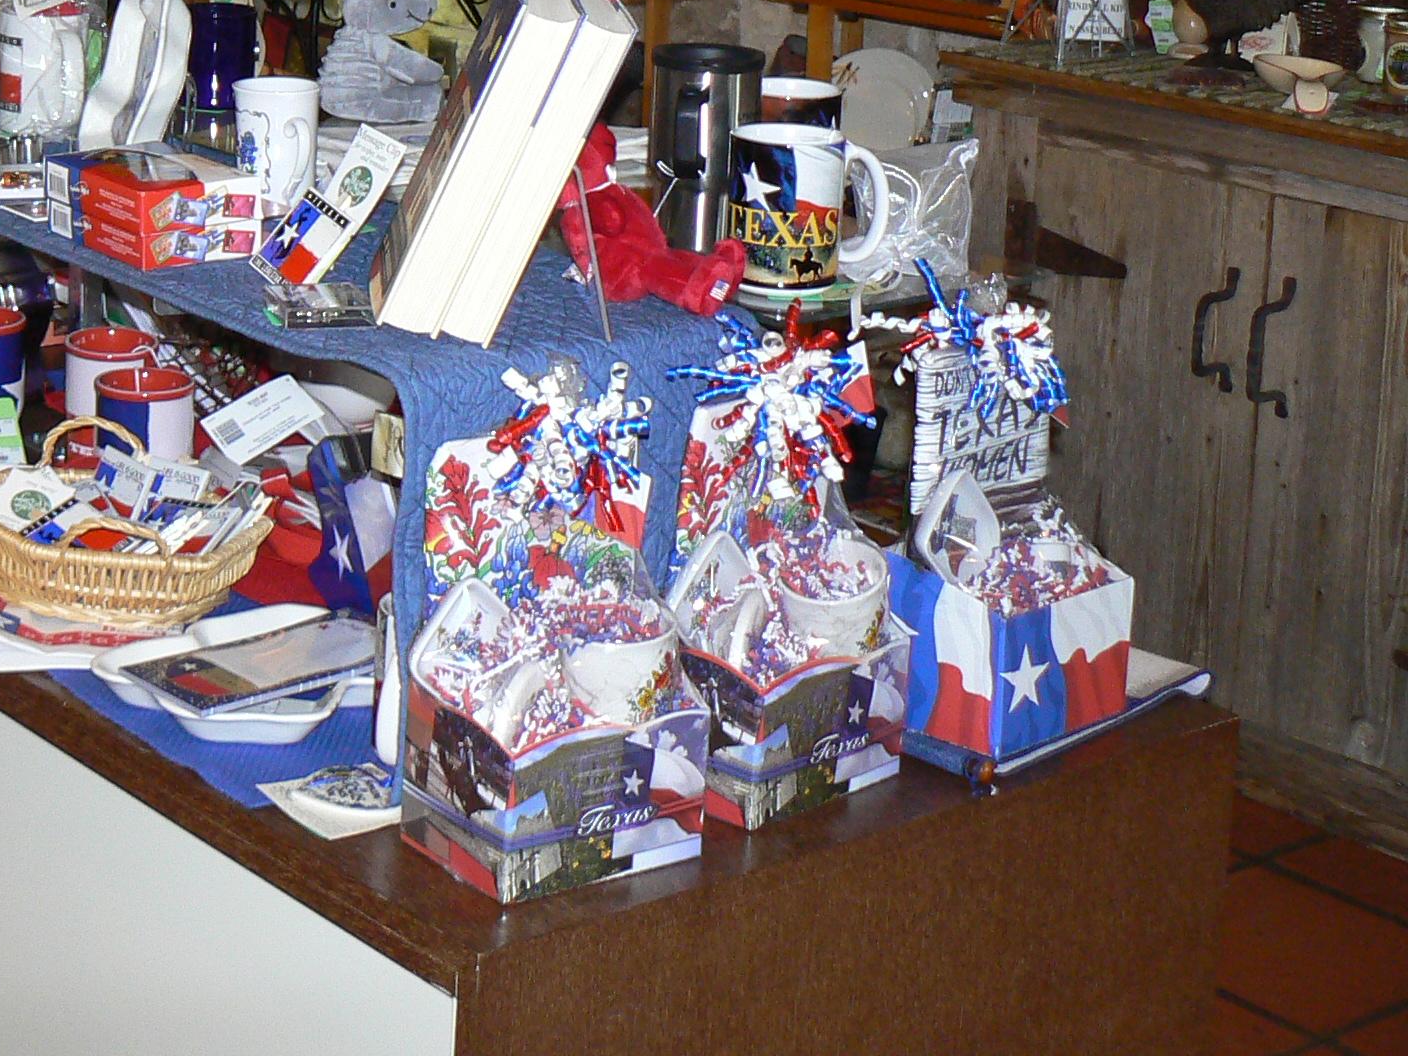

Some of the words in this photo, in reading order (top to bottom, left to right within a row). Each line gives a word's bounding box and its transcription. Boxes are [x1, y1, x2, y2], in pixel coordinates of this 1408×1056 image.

[728, 202, 839, 248] TEXAS
[810, 732, 870, 765] Texas
[577, 803, 659, 836] Texas
